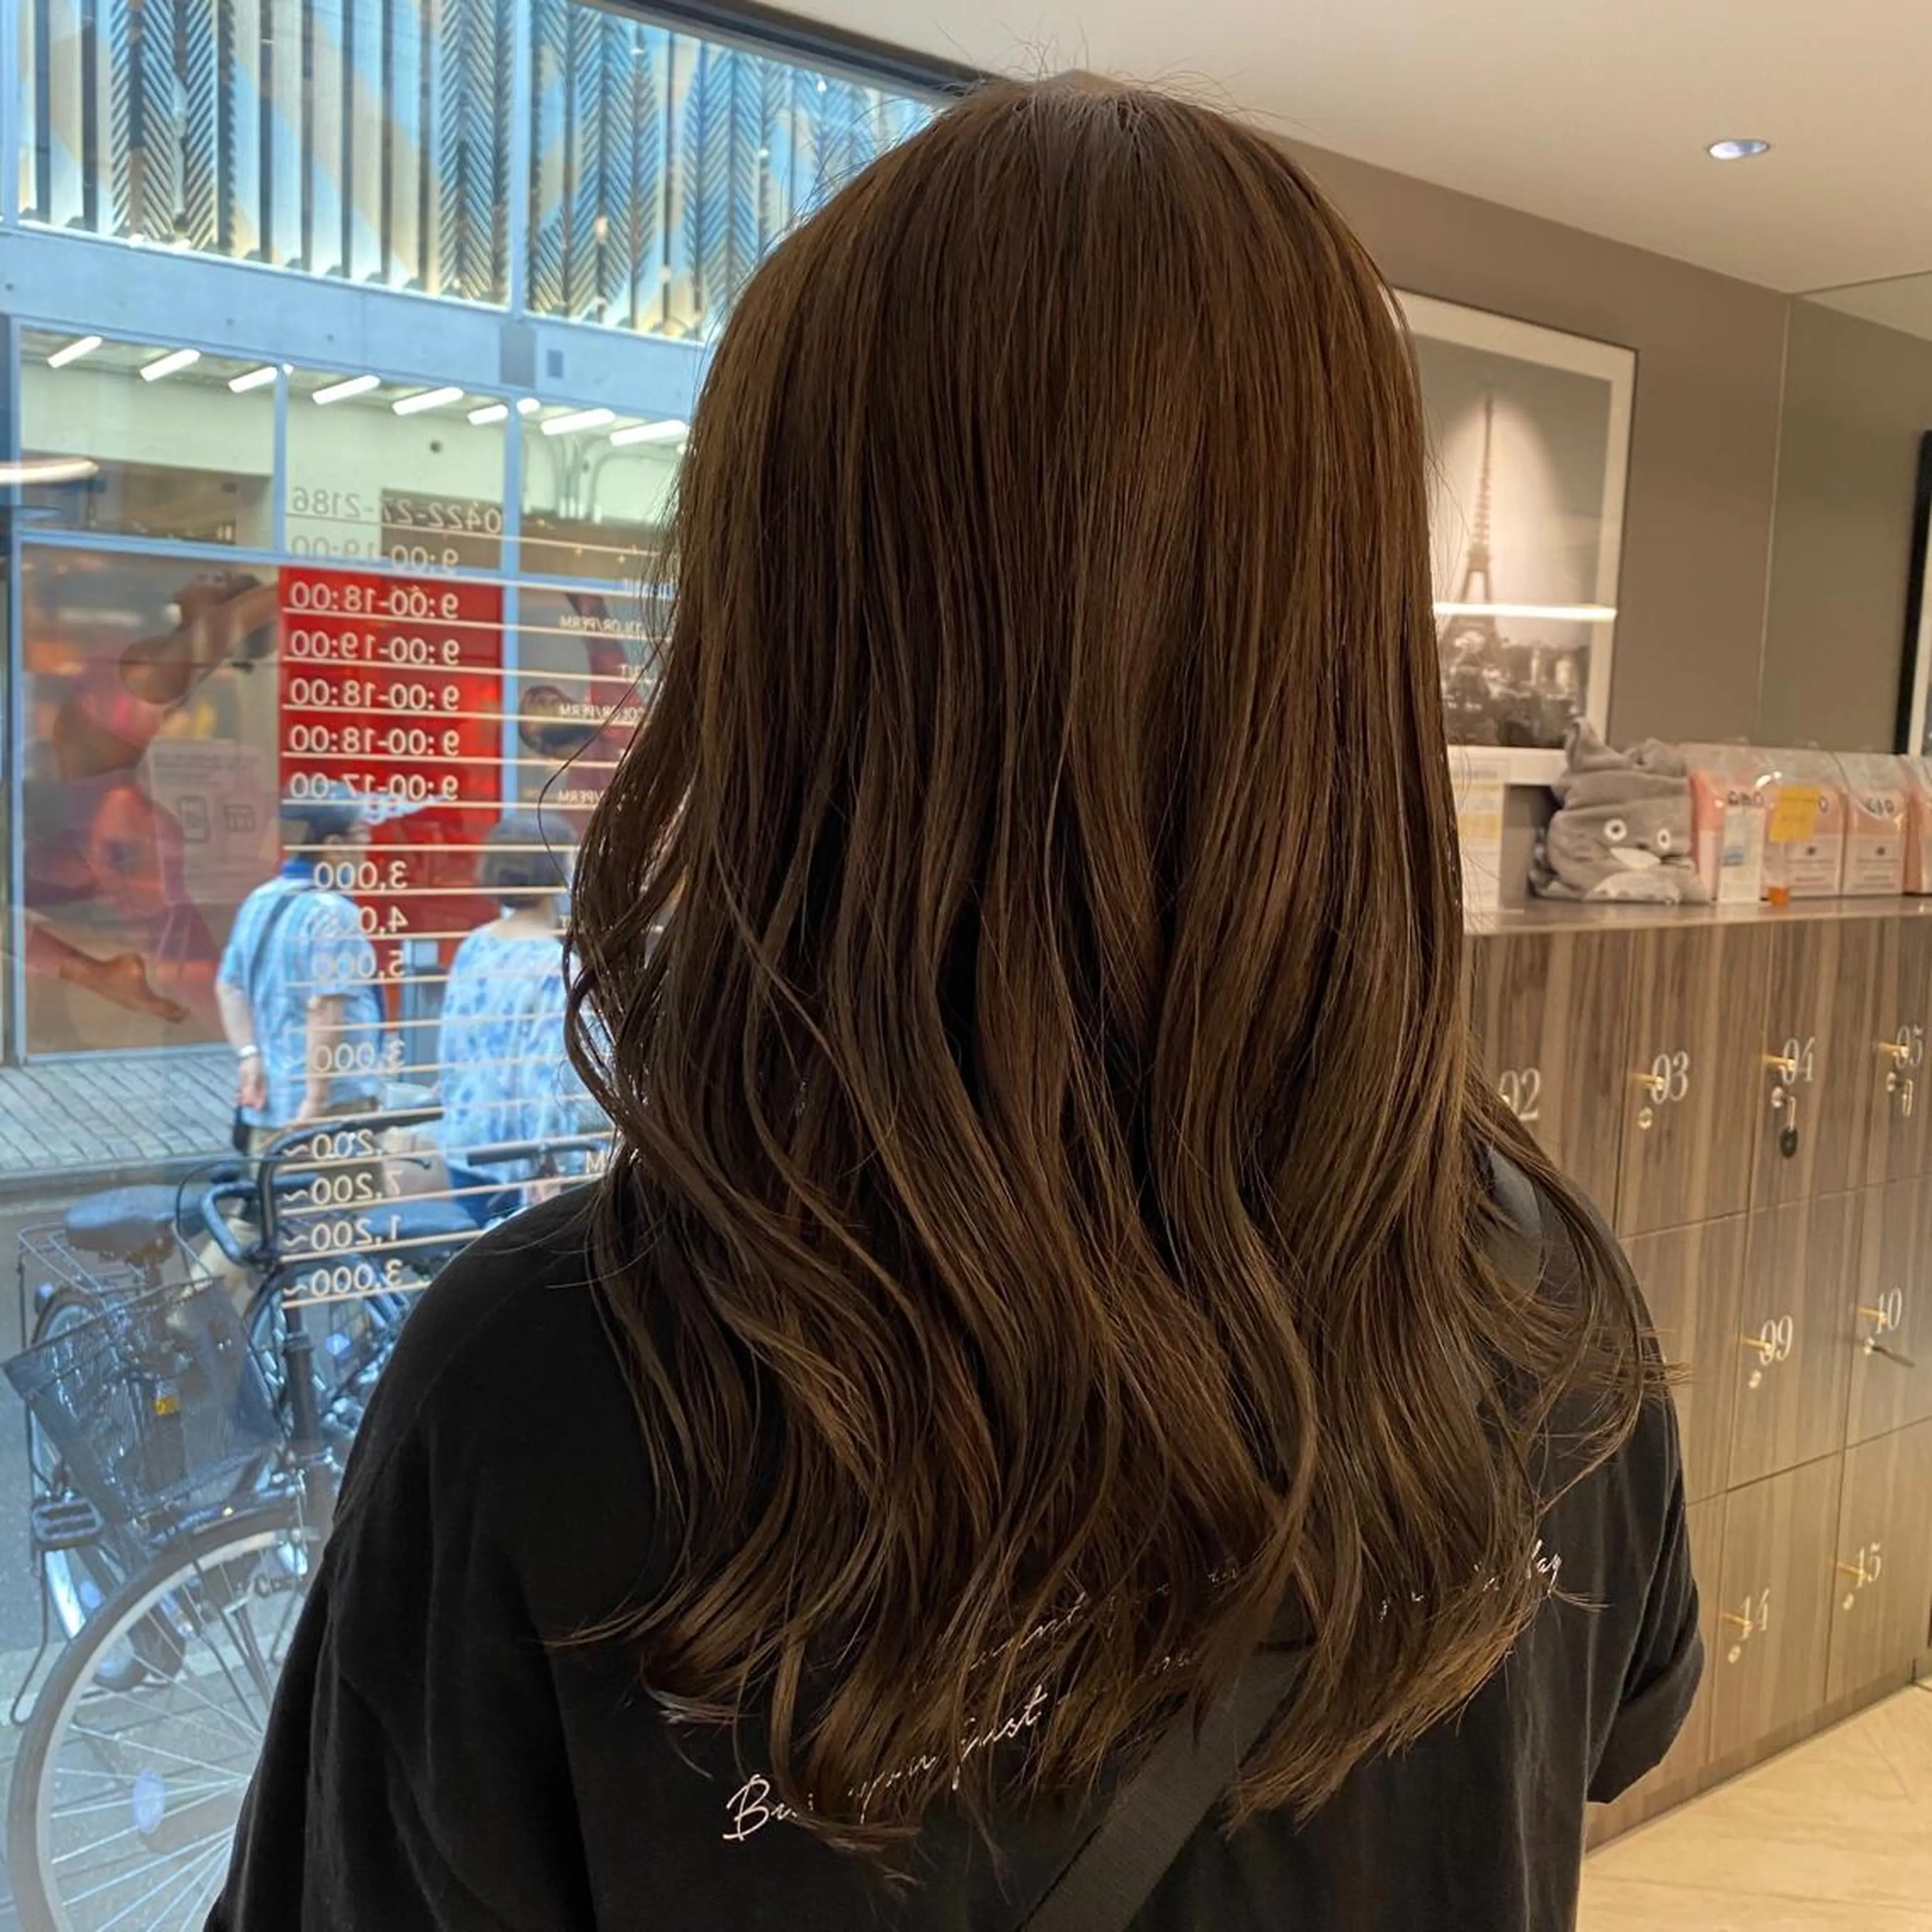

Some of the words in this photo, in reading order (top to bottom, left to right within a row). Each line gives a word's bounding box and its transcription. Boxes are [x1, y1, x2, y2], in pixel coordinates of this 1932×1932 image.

[1783, 1036, 1815, 1085] 04
[1895, 1024, 1923, 1070] 05
[1498, 1067, 1540, 1121] 02
[1650, 1050, 1689, 1104] 03
[1875, 1287, 1902, 1334] 10
[1759, 1314, 1793, 1365] 09
